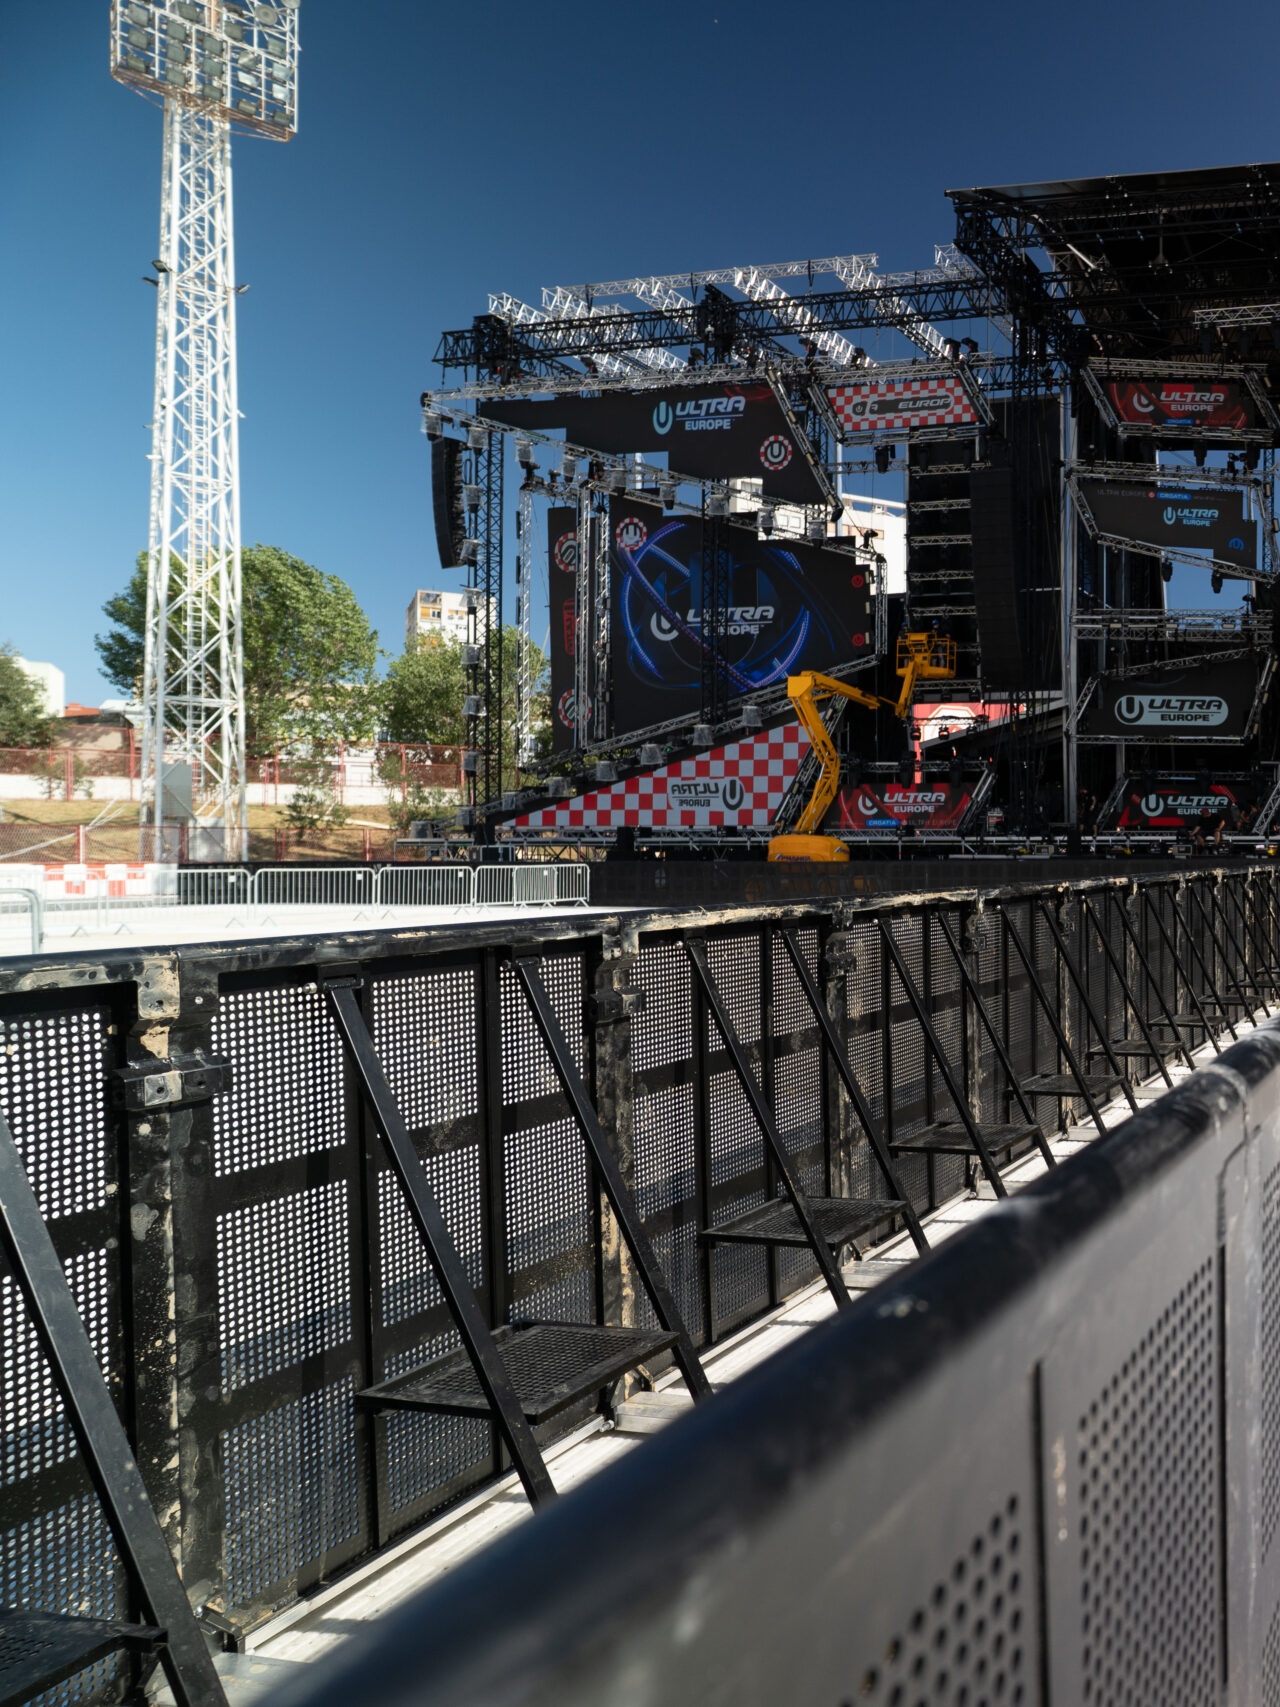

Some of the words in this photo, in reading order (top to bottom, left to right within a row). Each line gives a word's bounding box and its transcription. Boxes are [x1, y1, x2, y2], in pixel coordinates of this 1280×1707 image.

[1160, 391, 1225, 403] ULTRA
[675, 395, 747, 417] ULTRA
[898, 398, 951, 409] EUROP
[1171, 404, 1214, 412] EUROPE
[684, 419, 732, 431] EUROPE
[1176, 508, 1219, 519] ULTRA
[1183, 519, 1212, 527] EUROPE
[1148, 698, 1223, 712] ULTRA
[1160, 713, 1210, 722] EUROPE
[883, 792, 946, 803] ULTRA
[1167, 795, 1229, 806] ULTRA
[893, 805, 936, 813] EUROPE
